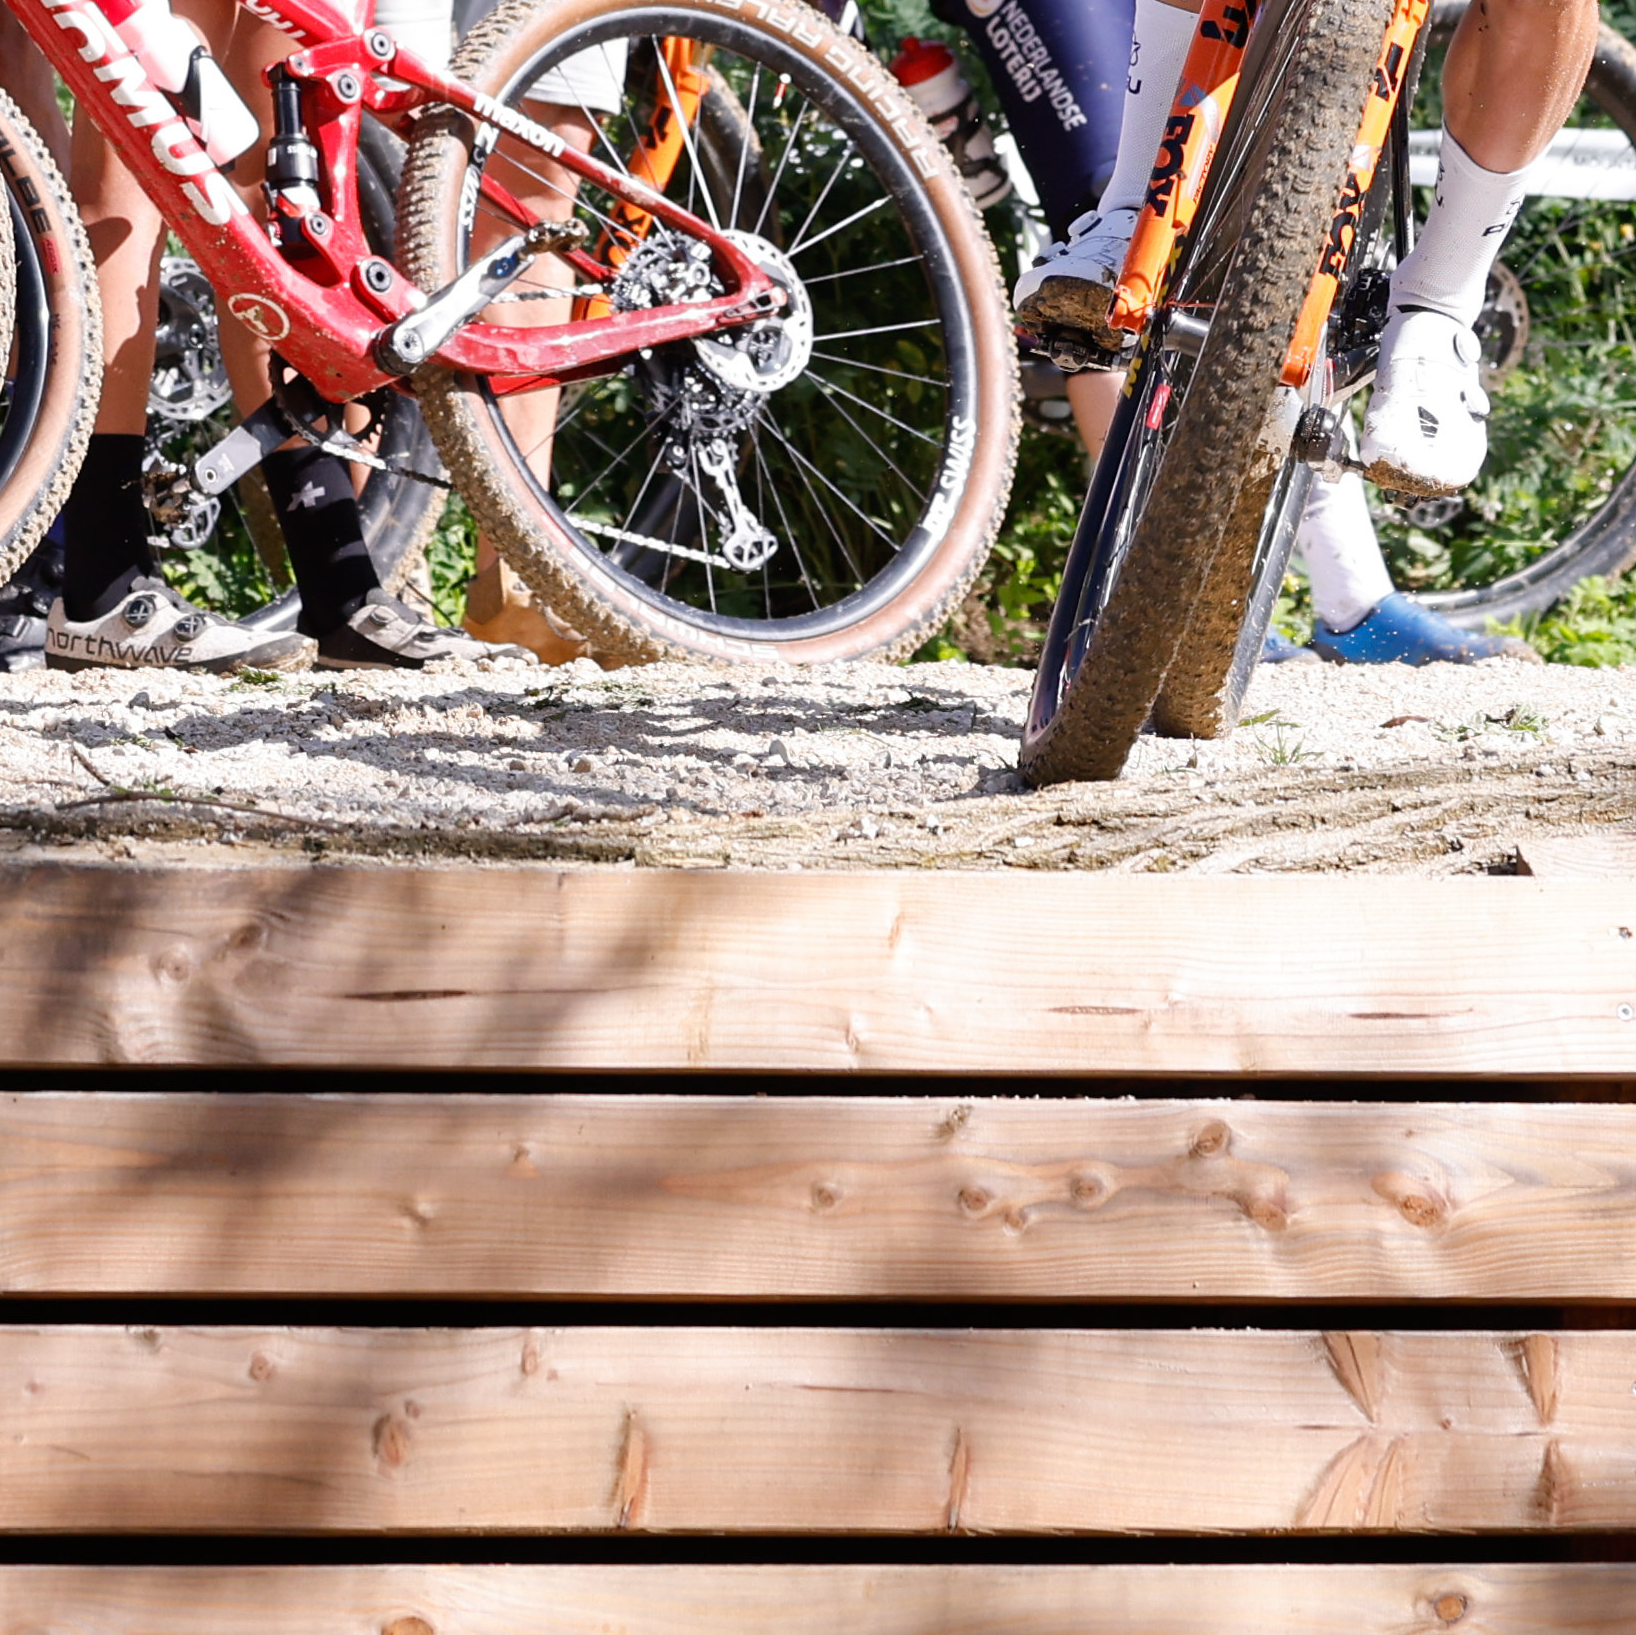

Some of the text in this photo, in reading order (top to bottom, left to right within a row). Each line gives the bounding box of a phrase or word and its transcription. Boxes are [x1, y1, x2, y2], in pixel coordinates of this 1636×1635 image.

[985, 15, 1042, 104] LOTERIJ
[473, 92, 566, 157] maxon
[1145, 114, 1195, 217] FOX
